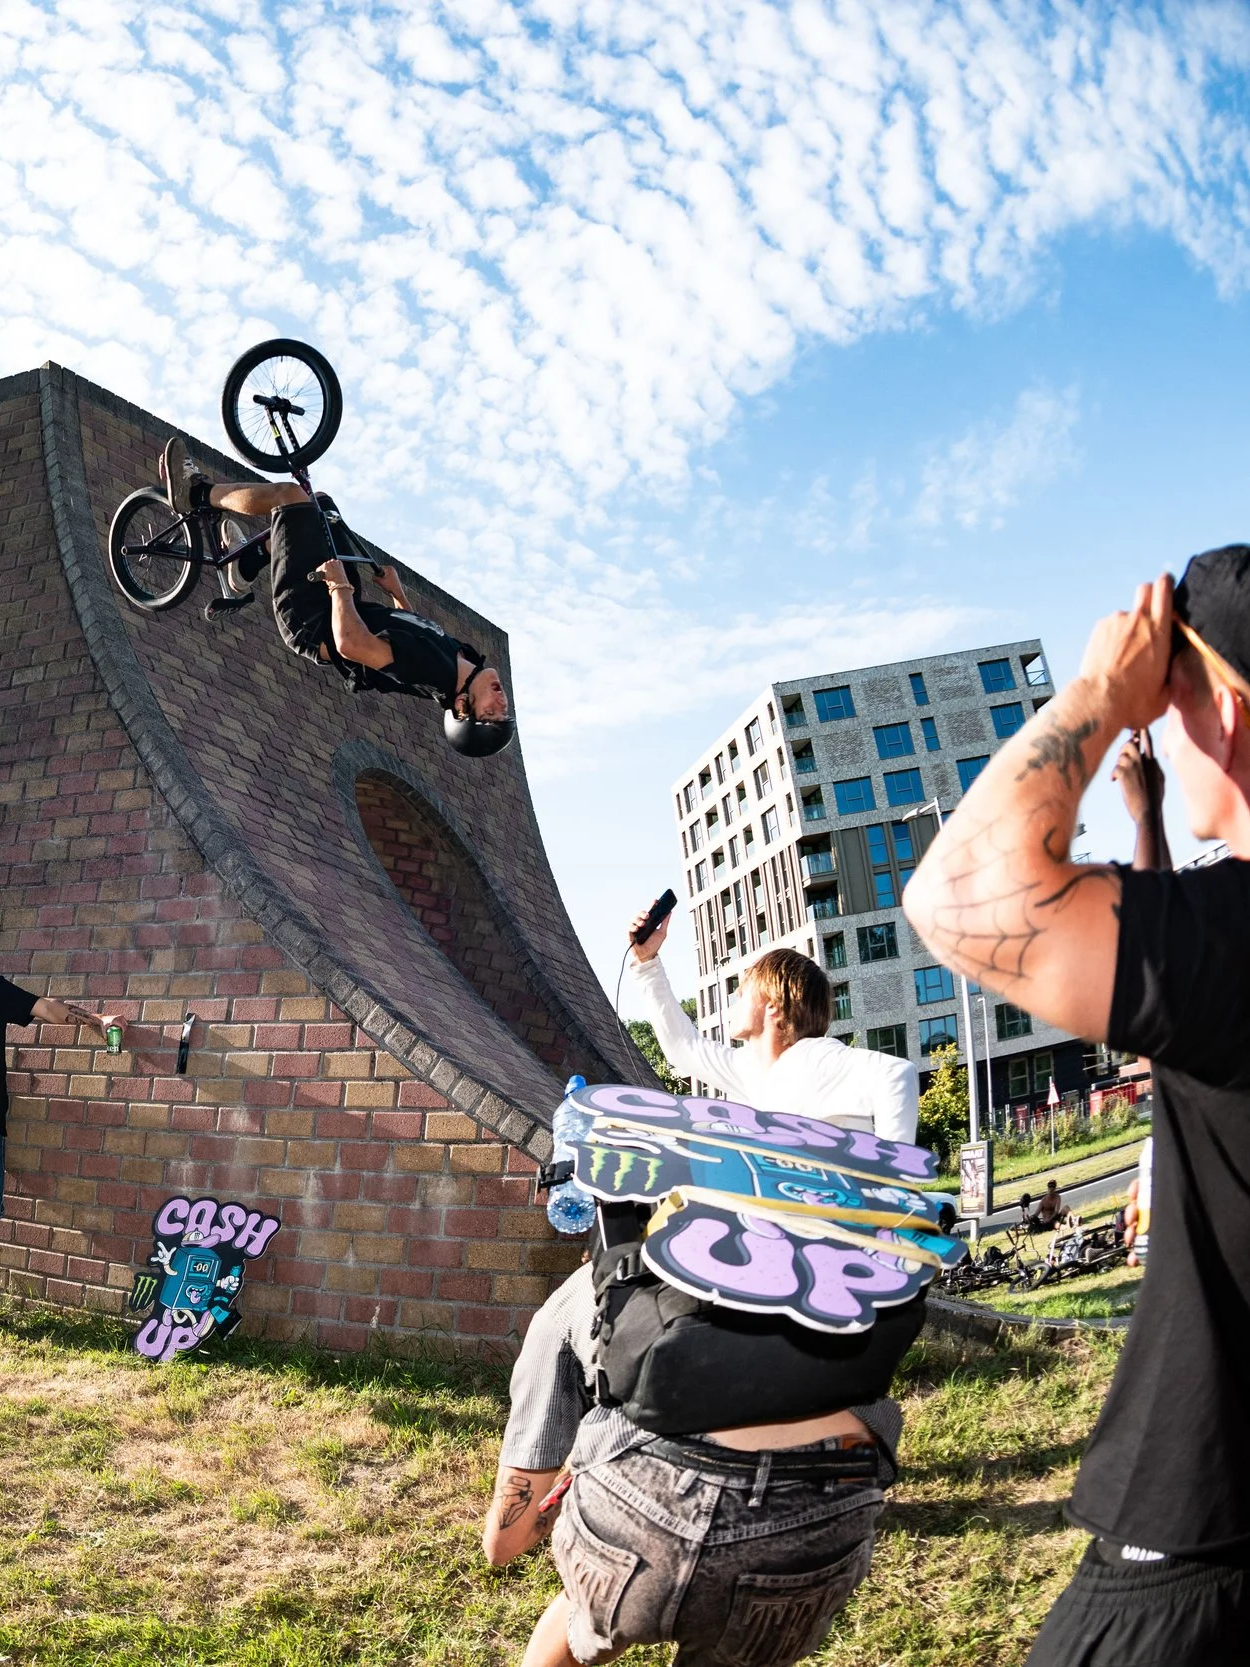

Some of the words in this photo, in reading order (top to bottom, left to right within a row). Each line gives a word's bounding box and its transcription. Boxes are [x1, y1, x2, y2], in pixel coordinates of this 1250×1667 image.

[588, 1085, 933, 1176] CASH
[155, 1198, 279, 1256] CASH
[669, 1217, 909, 1318] UP
[135, 1318, 200, 1362] UP
